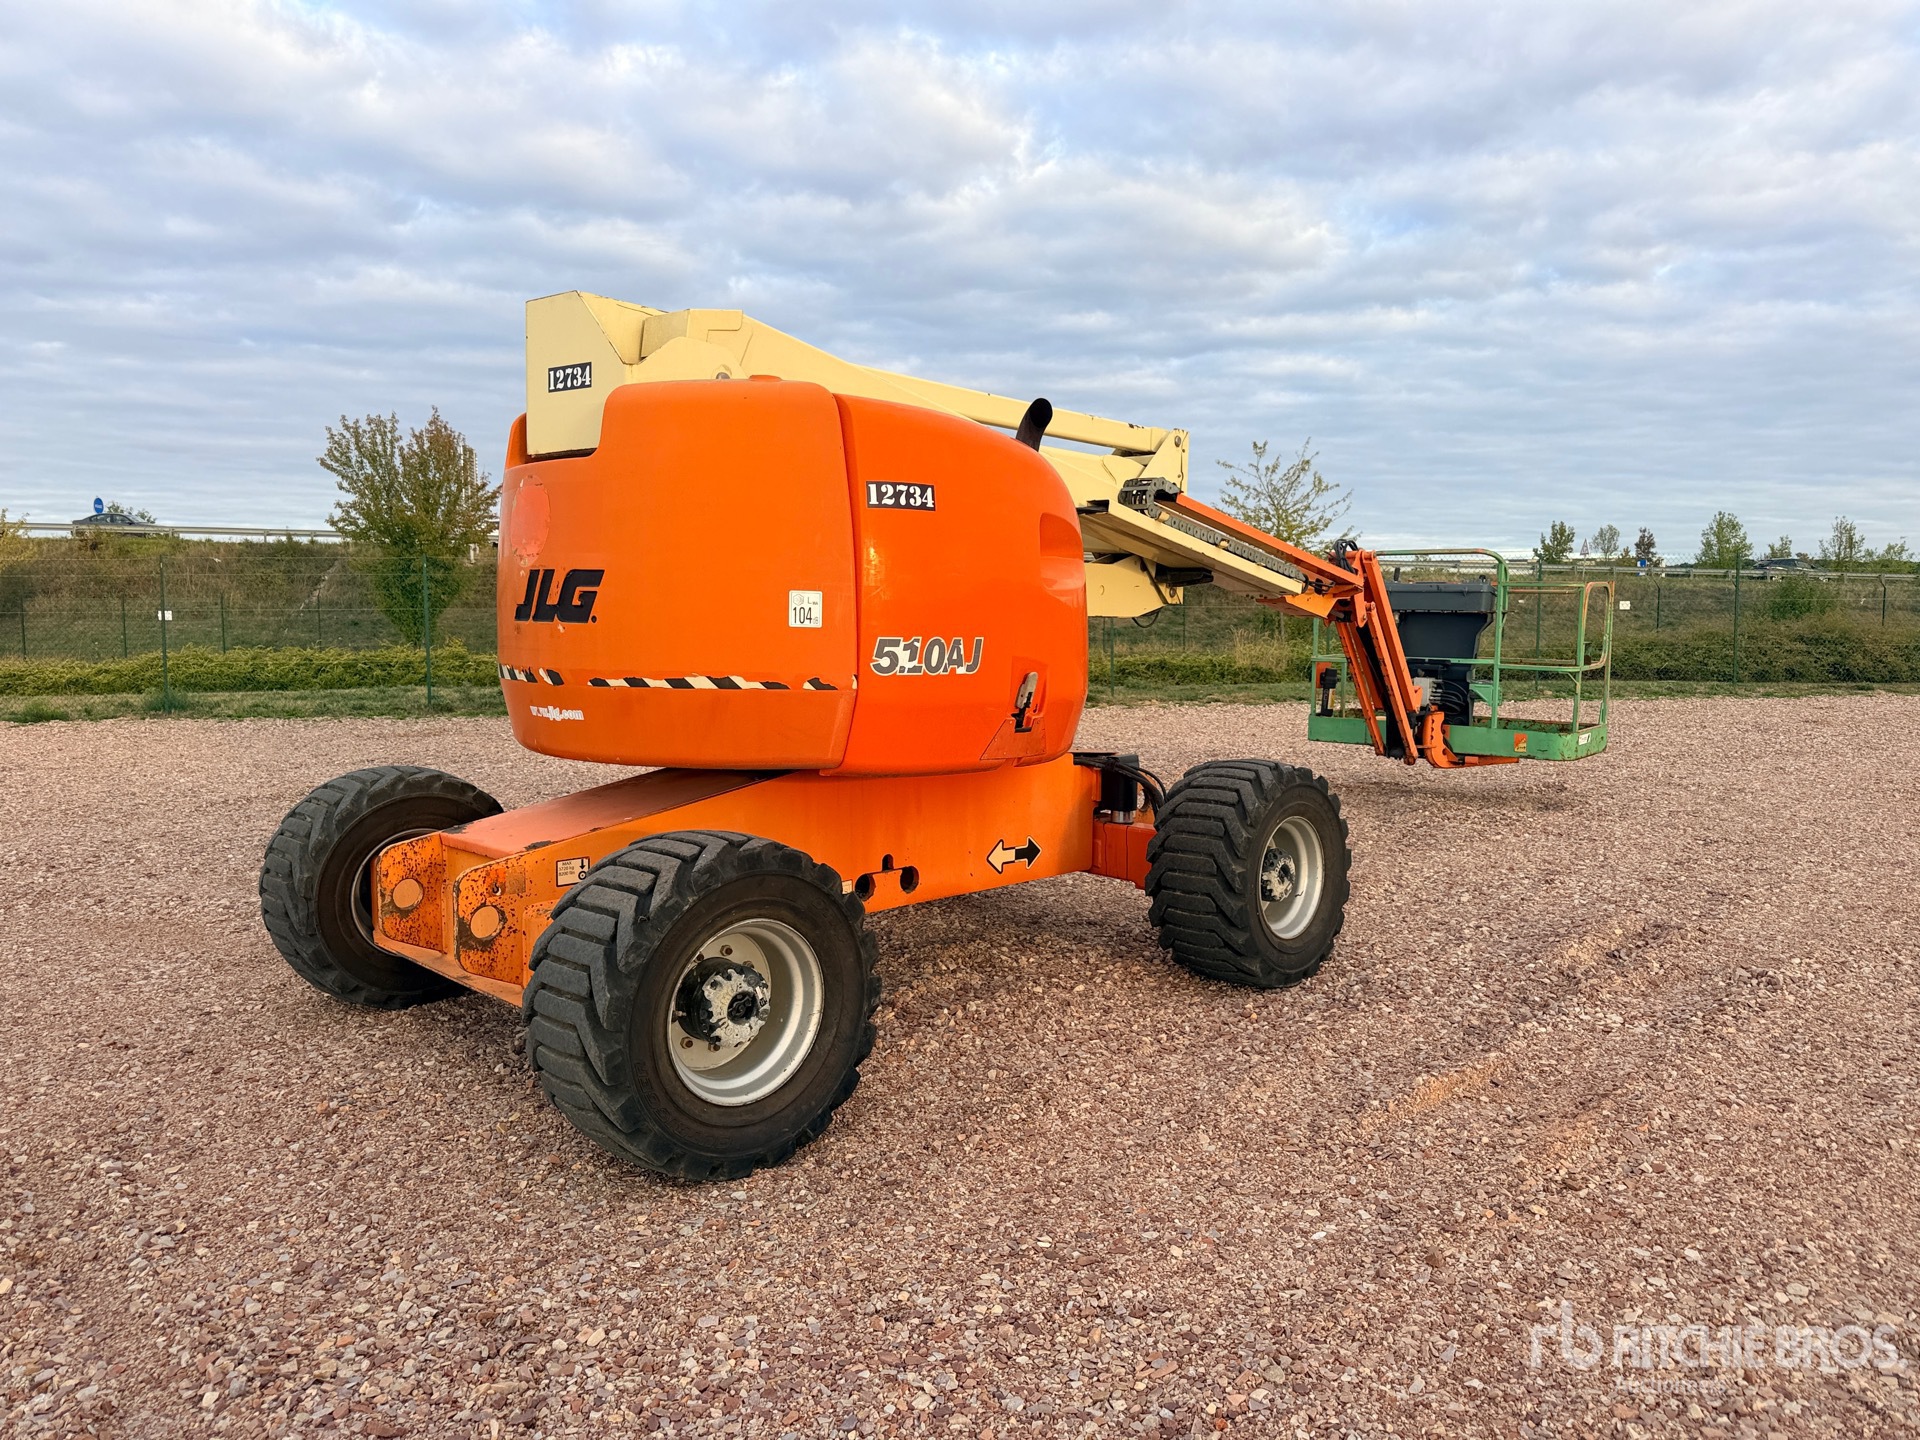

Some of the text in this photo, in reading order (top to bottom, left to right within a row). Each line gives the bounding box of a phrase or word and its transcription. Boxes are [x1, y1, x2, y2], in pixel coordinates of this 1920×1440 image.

[549, 365, 591, 390] 12734
[868, 483, 934, 508] 12734
[792, 606, 813, 625] 104
